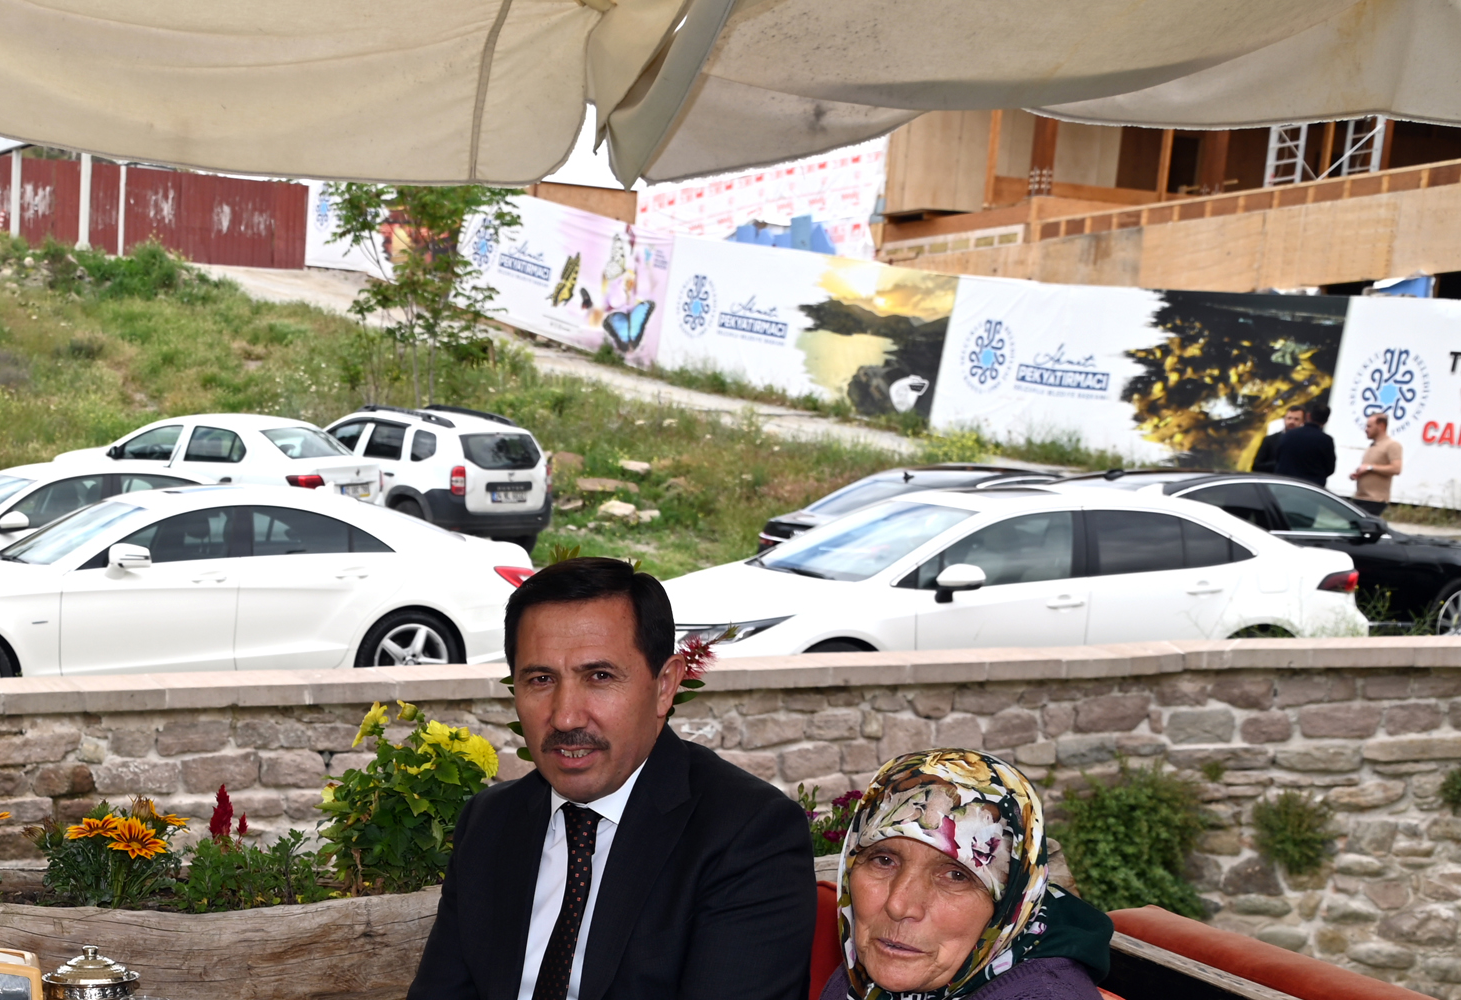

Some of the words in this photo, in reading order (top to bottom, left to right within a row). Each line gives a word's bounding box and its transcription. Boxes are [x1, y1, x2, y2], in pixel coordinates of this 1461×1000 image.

[719, 314, 787, 338] PEKYATIRMACI
[1017, 365, 1108, 391] PEKYATIRMACI
[1422, 420, 1461, 446] CA
